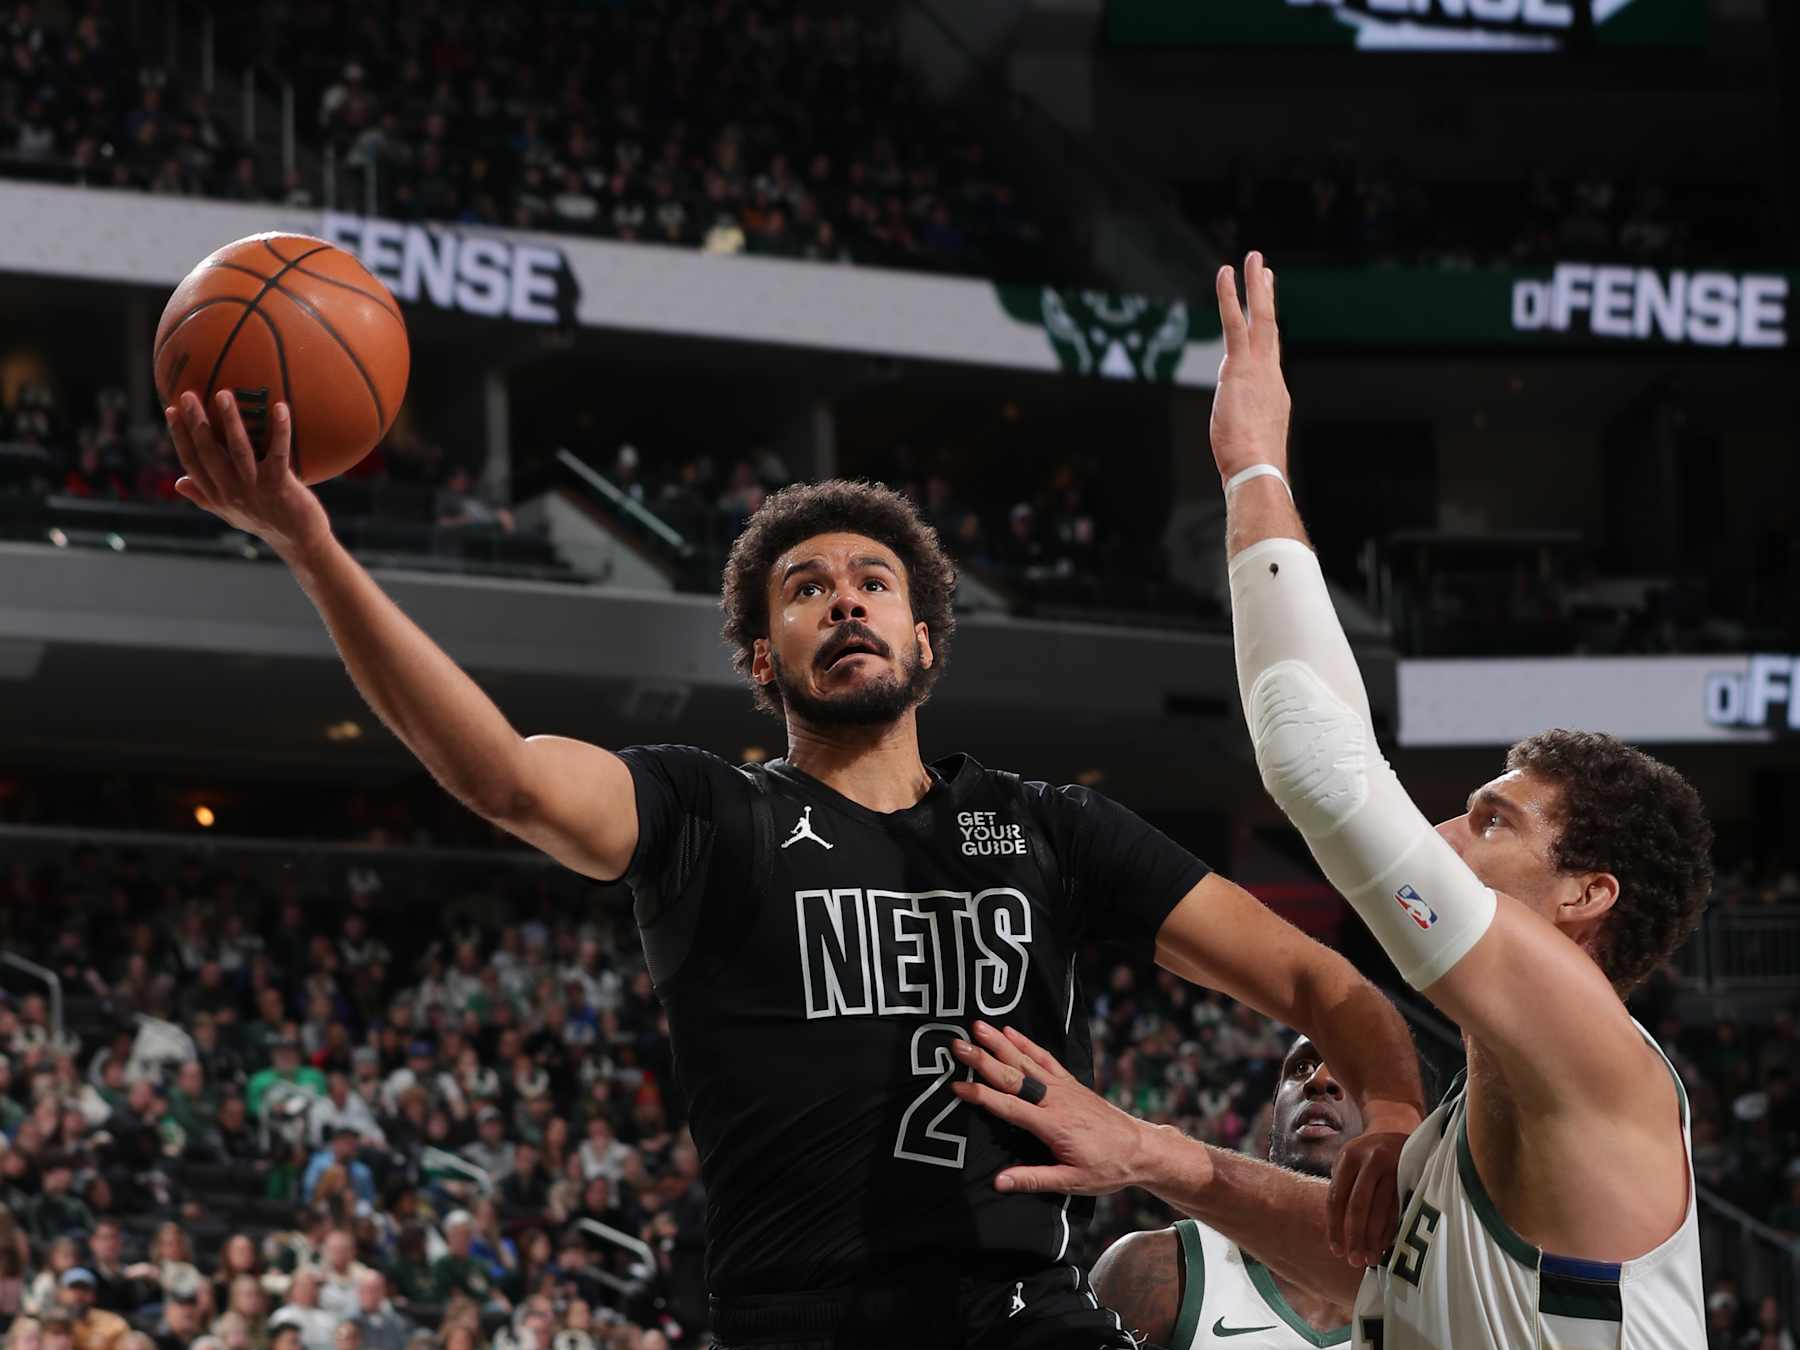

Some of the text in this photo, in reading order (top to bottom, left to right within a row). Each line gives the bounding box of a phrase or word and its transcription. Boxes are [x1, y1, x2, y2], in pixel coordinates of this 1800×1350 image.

[957, 811, 997, 826] GET
[959, 824, 1021, 841] YOUR
[961, 839, 1027, 856] GUIDE
[795, 887, 1032, 1019] NETS
[893, 1022, 975, 1168] 2
